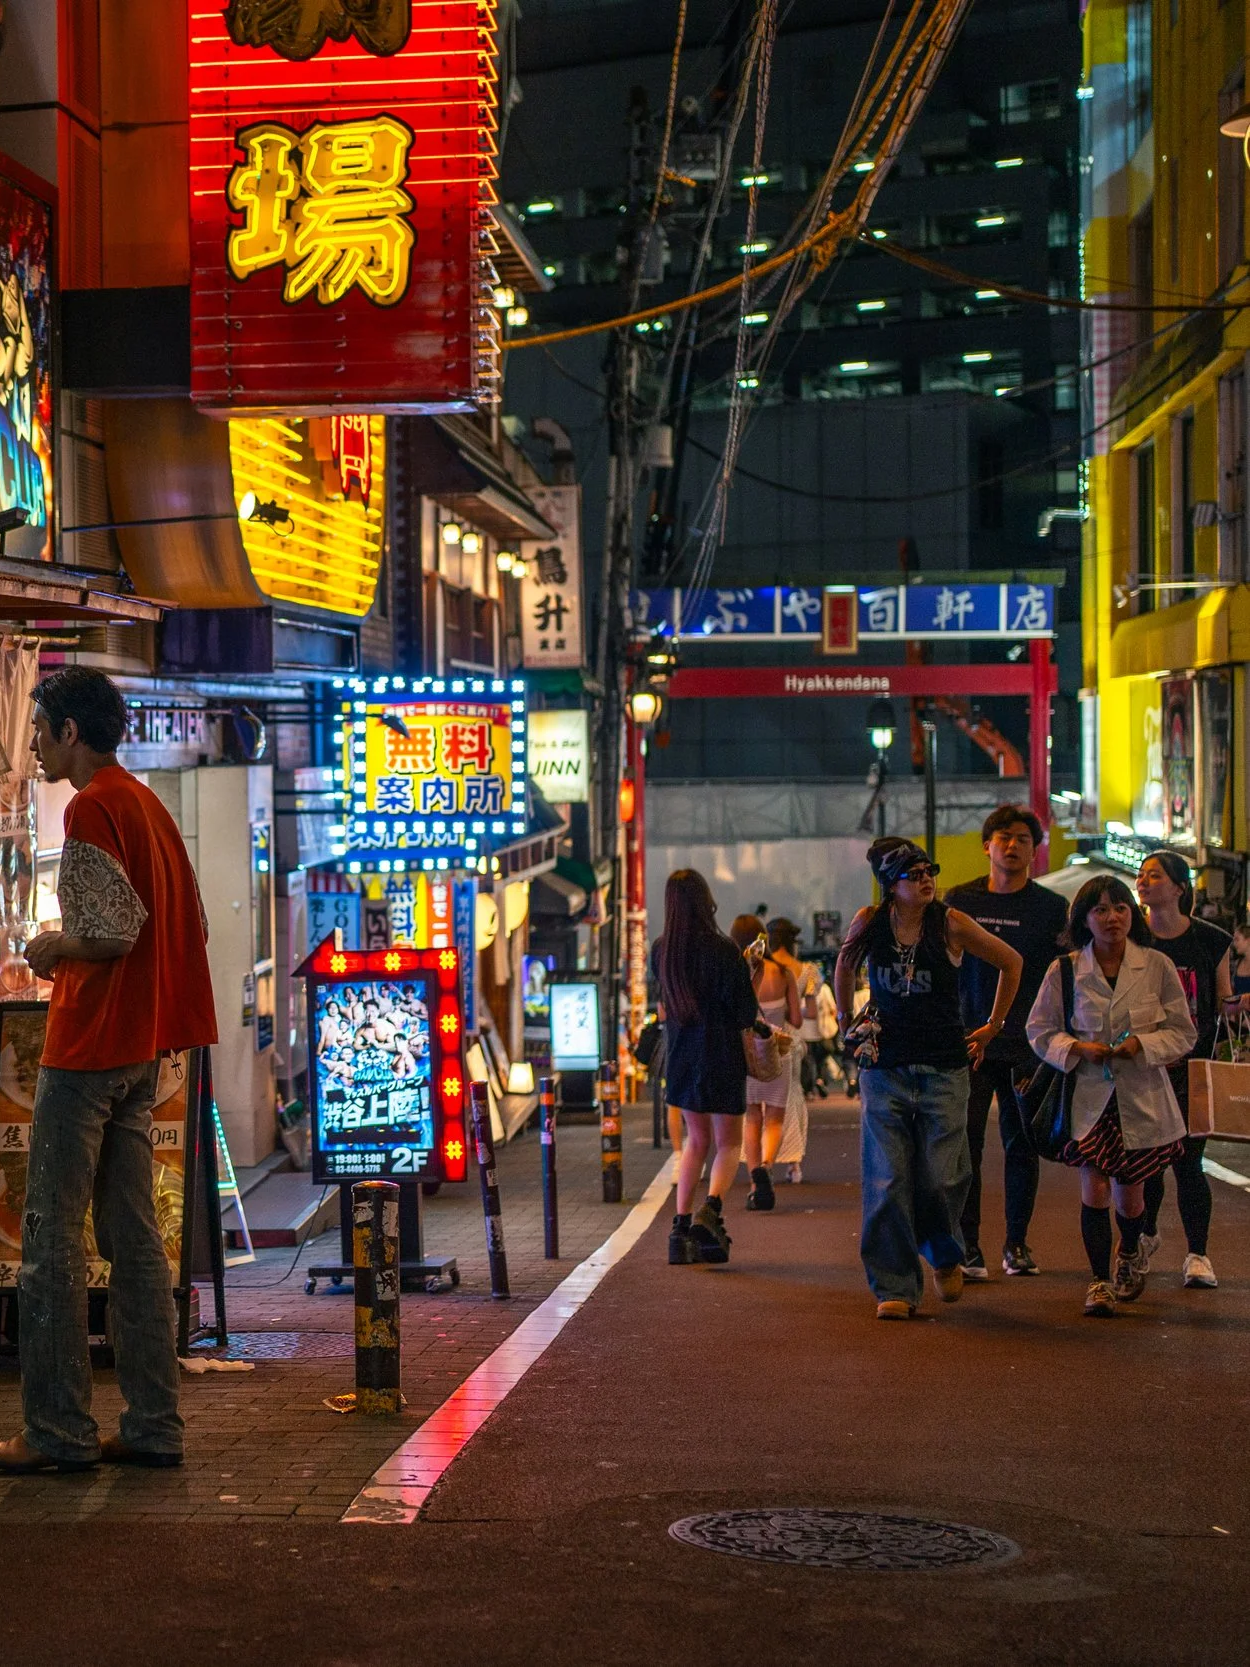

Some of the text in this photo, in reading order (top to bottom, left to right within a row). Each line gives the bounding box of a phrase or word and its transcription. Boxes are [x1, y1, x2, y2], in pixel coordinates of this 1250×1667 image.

[784, 674, 890, 692] Hyakkendana
[384, 723, 492, 773] 無料
[534, 759, 581, 776] JINN
[375, 774, 503, 815] 案内所
[391, 1147, 428, 1173] 2F
